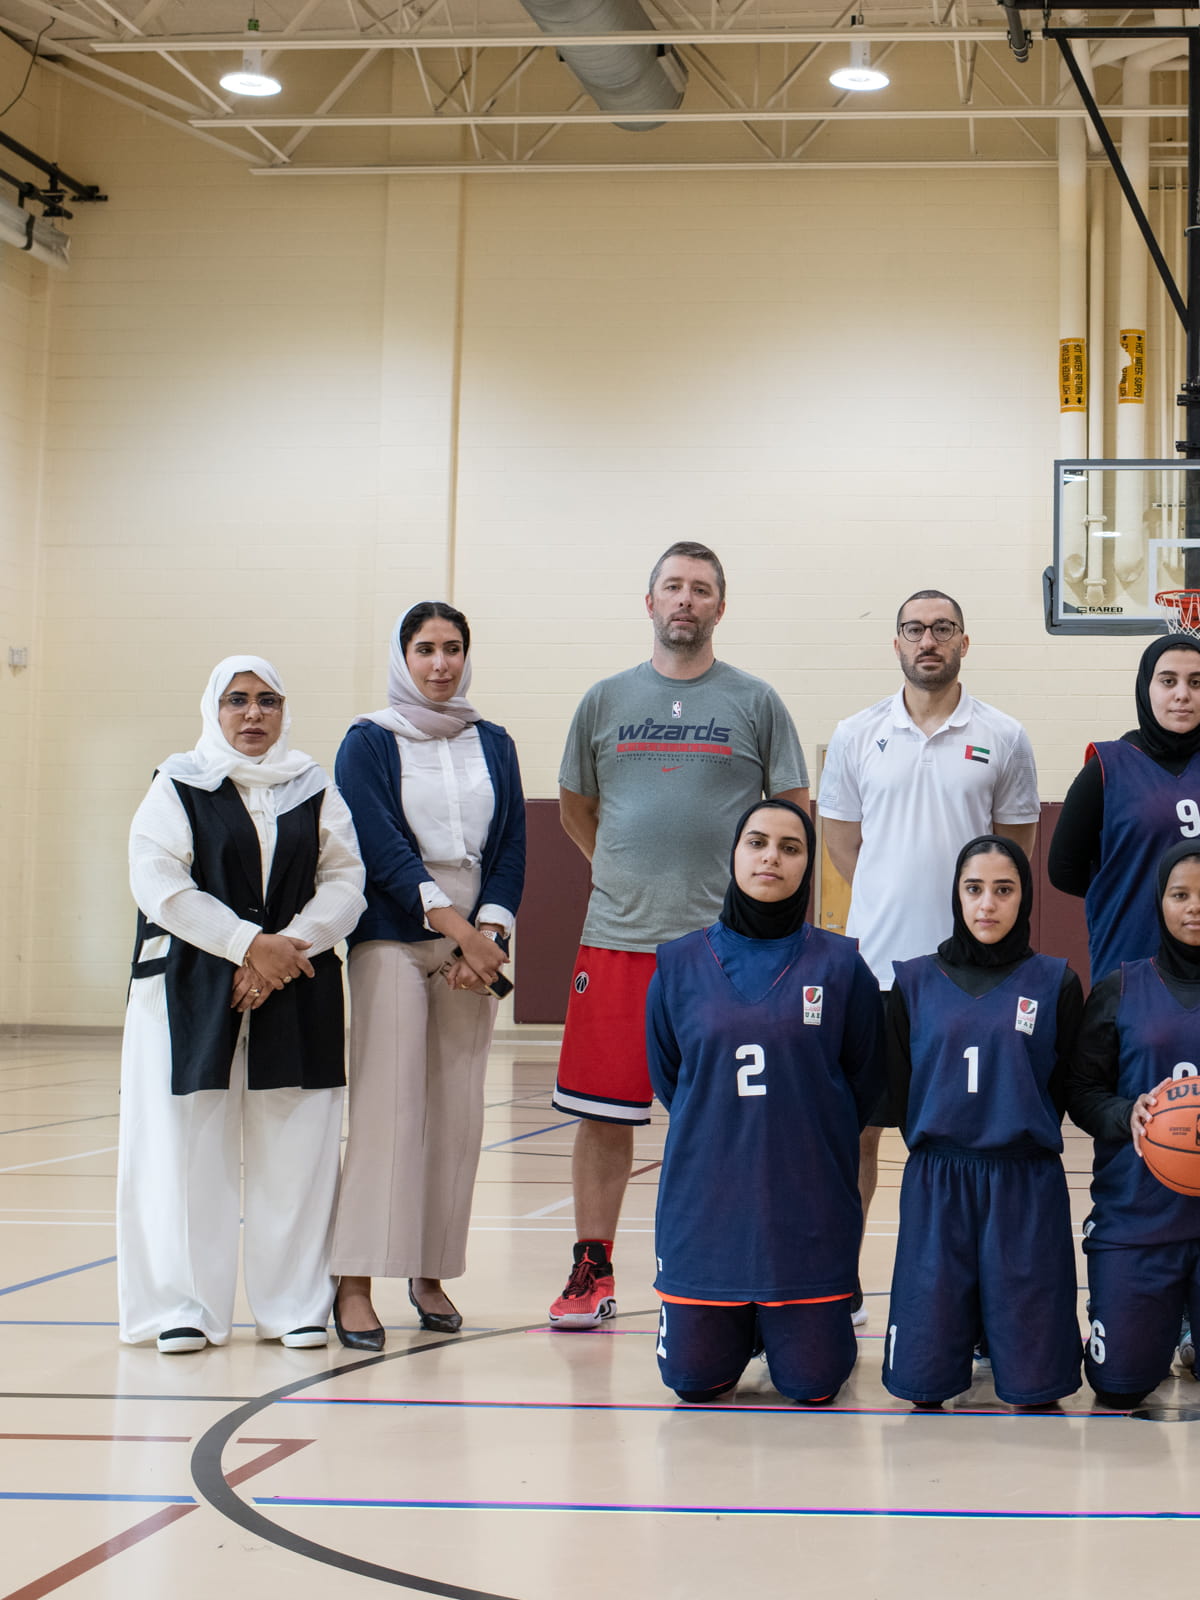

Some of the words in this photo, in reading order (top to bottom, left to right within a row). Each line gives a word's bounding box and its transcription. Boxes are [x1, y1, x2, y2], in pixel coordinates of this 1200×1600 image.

[618, 717, 733, 743] wizards
[805, 1011, 821, 1019] UAE
[735, 1044, 767, 1097] 2
[963, 1046, 979, 1093] 1
[656, 1305, 667, 1359] 2
[889, 1324, 898, 1371] 1
[1090, 1319, 1106, 1364] 6
